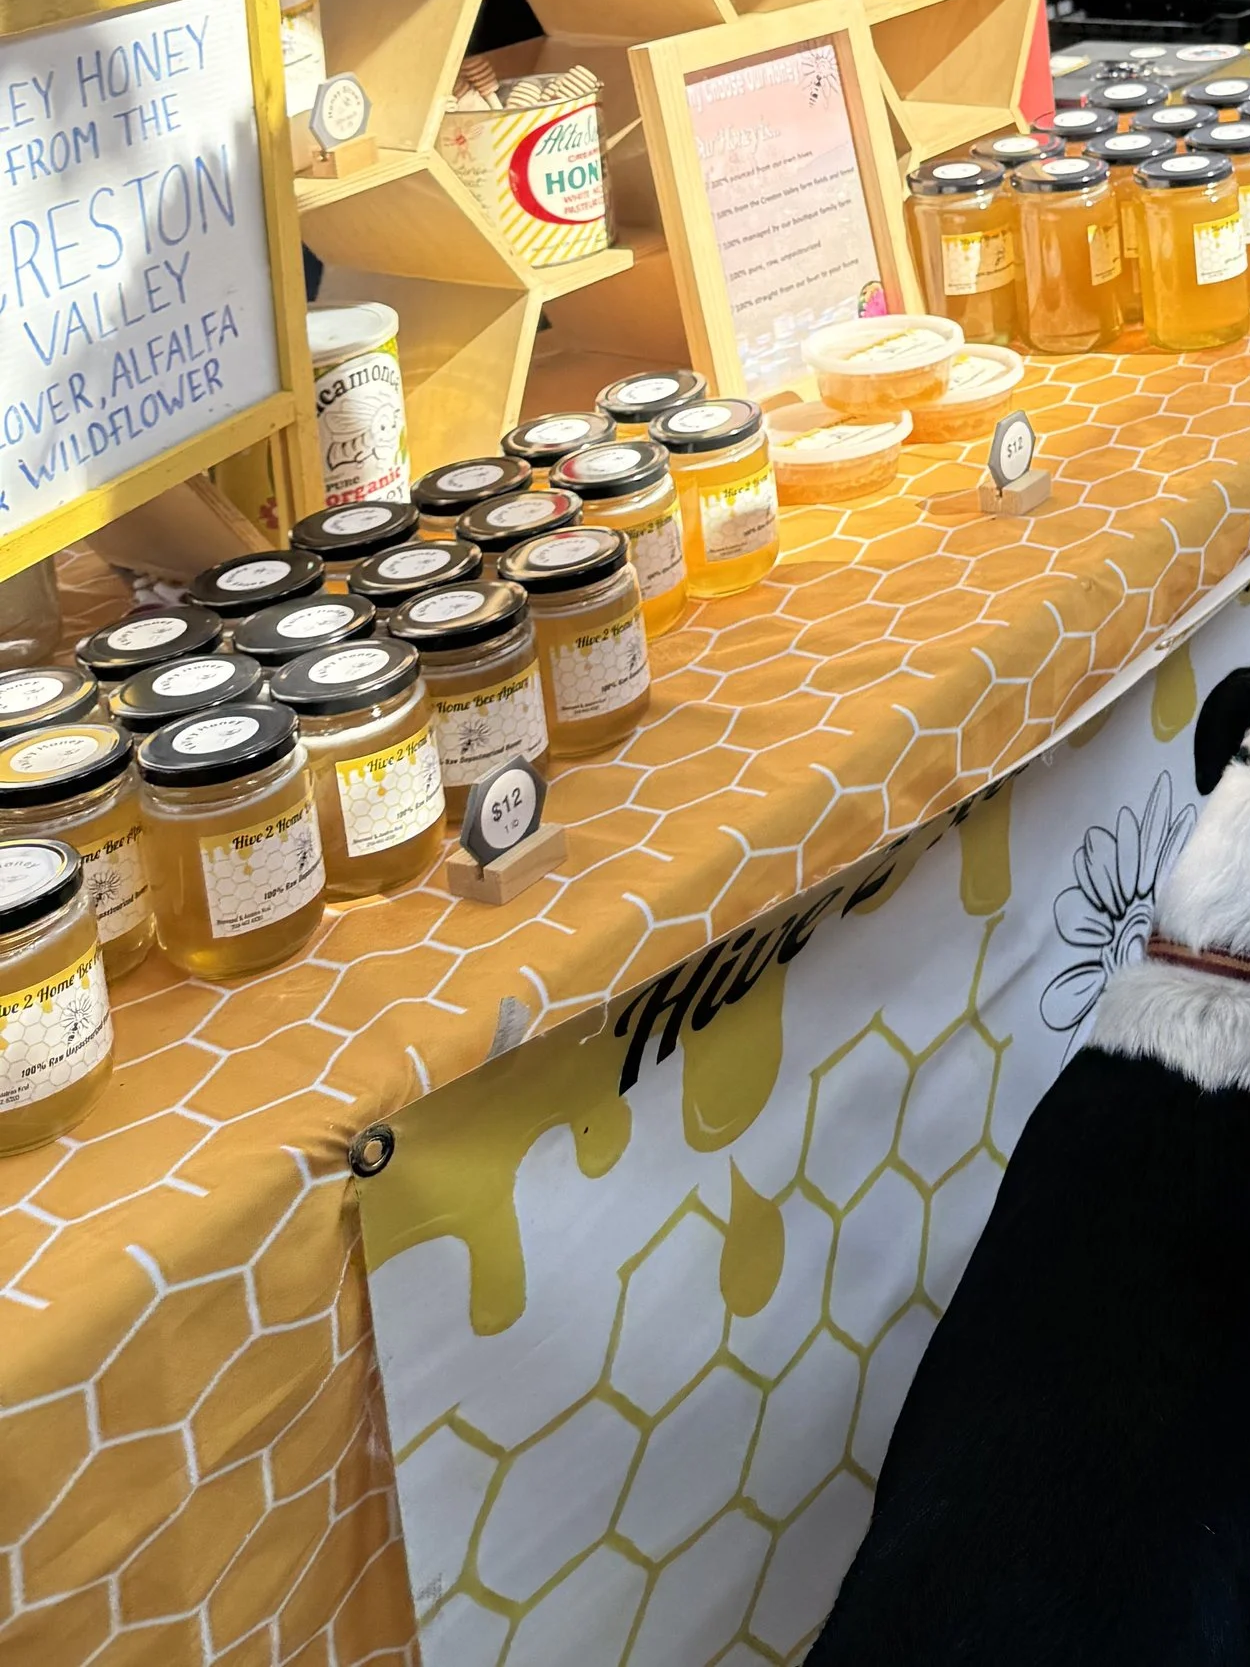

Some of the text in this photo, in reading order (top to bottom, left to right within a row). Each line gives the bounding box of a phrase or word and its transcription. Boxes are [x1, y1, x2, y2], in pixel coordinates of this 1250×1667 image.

[0, 15, 209, 133] EY HONEY
[4, 93, 183, 186] FROM THE
[0, 144, 235, 315] RESTON
[23, 251, 190, 366] VALLEY
[0, 303, 239, 450] OVER, ALFALFA
[18, 357, 224, 490] WILDFLOWER
[1006, 436, 1024, 458] $12
[575, 635, 601, 650] Hive
[603, 628, 610, 641] 2
[436, 697, 473, 715] Home
[473, 691, 497, 709] Bee
[366, 754, 395, 772] Hive
[395, 748, 404, 761] 2
[490, 787, 523, 822] $12
[101, 834, 124, 856] Bee
[231, 833, 264, 851] Hive
[264, 824, 275, 840] 2
[263, 886, 285, 901] 100%
[0, 1003, 20, 1018] ive
[23, 994, 34, 1011] 2
[36, 973, 76, 1004] Home
[21, 1062, 47, 1079] 100%
[48, 1054, 64, 1068] Raw
